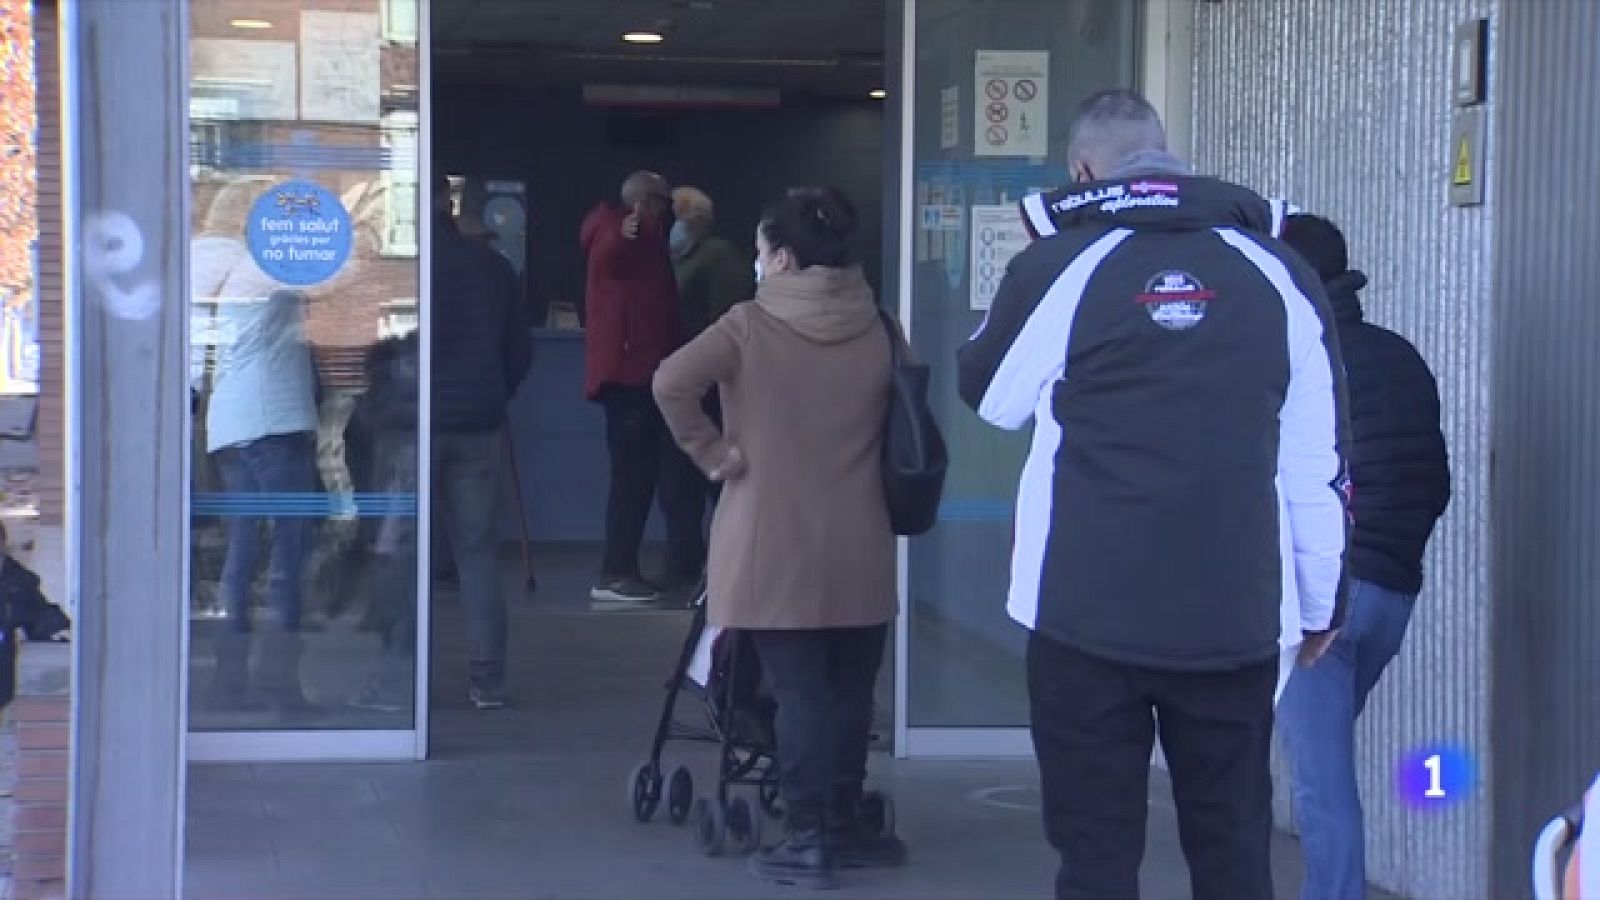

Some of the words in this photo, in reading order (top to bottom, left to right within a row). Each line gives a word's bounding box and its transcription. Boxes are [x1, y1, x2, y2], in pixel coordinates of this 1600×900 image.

[262, 217, 293, 232] fem
[299, 217, 338, 232] salut
[262, 249, 284, 260] no
[289, 246, 336, 260] fumar
